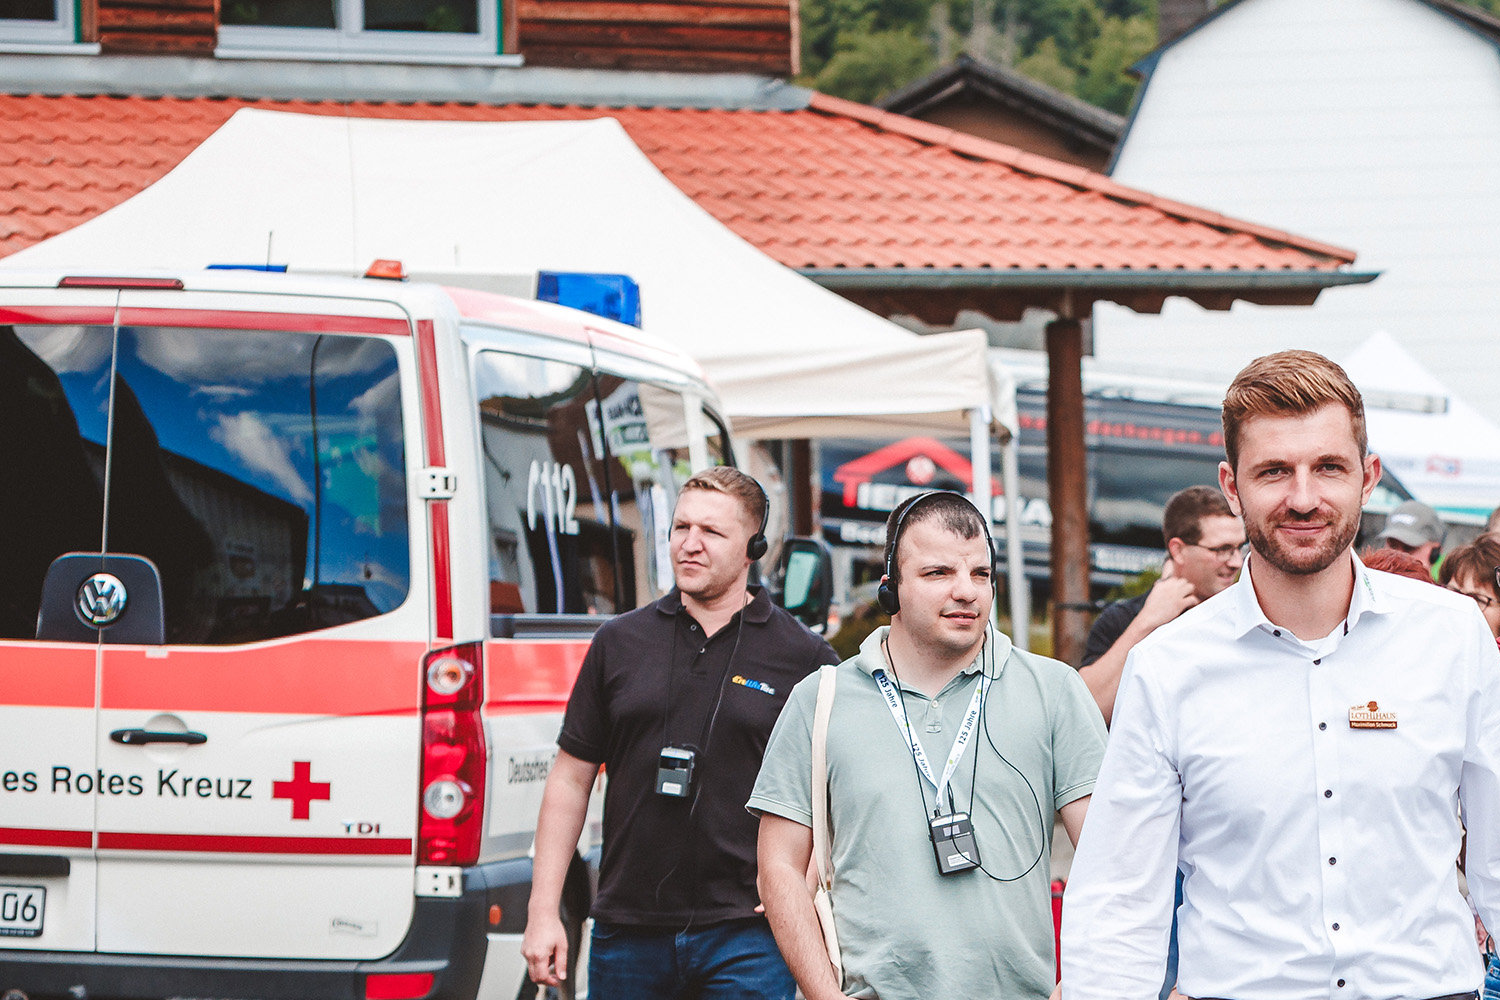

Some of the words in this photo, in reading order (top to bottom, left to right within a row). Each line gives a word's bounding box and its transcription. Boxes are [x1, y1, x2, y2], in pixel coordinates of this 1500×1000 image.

[879, 674, 889, 688] 125
[885, 685, 898, 709] Jahre
[958, 730, 969, 745] 125
[964, 709, 977, 731] Jahre
[3, 771, 38, 792] es
[51, 766, 143, 796] Rotes
[157, 769, 252, 799] Kreuz
[341, 822, 381, 835] TDI
